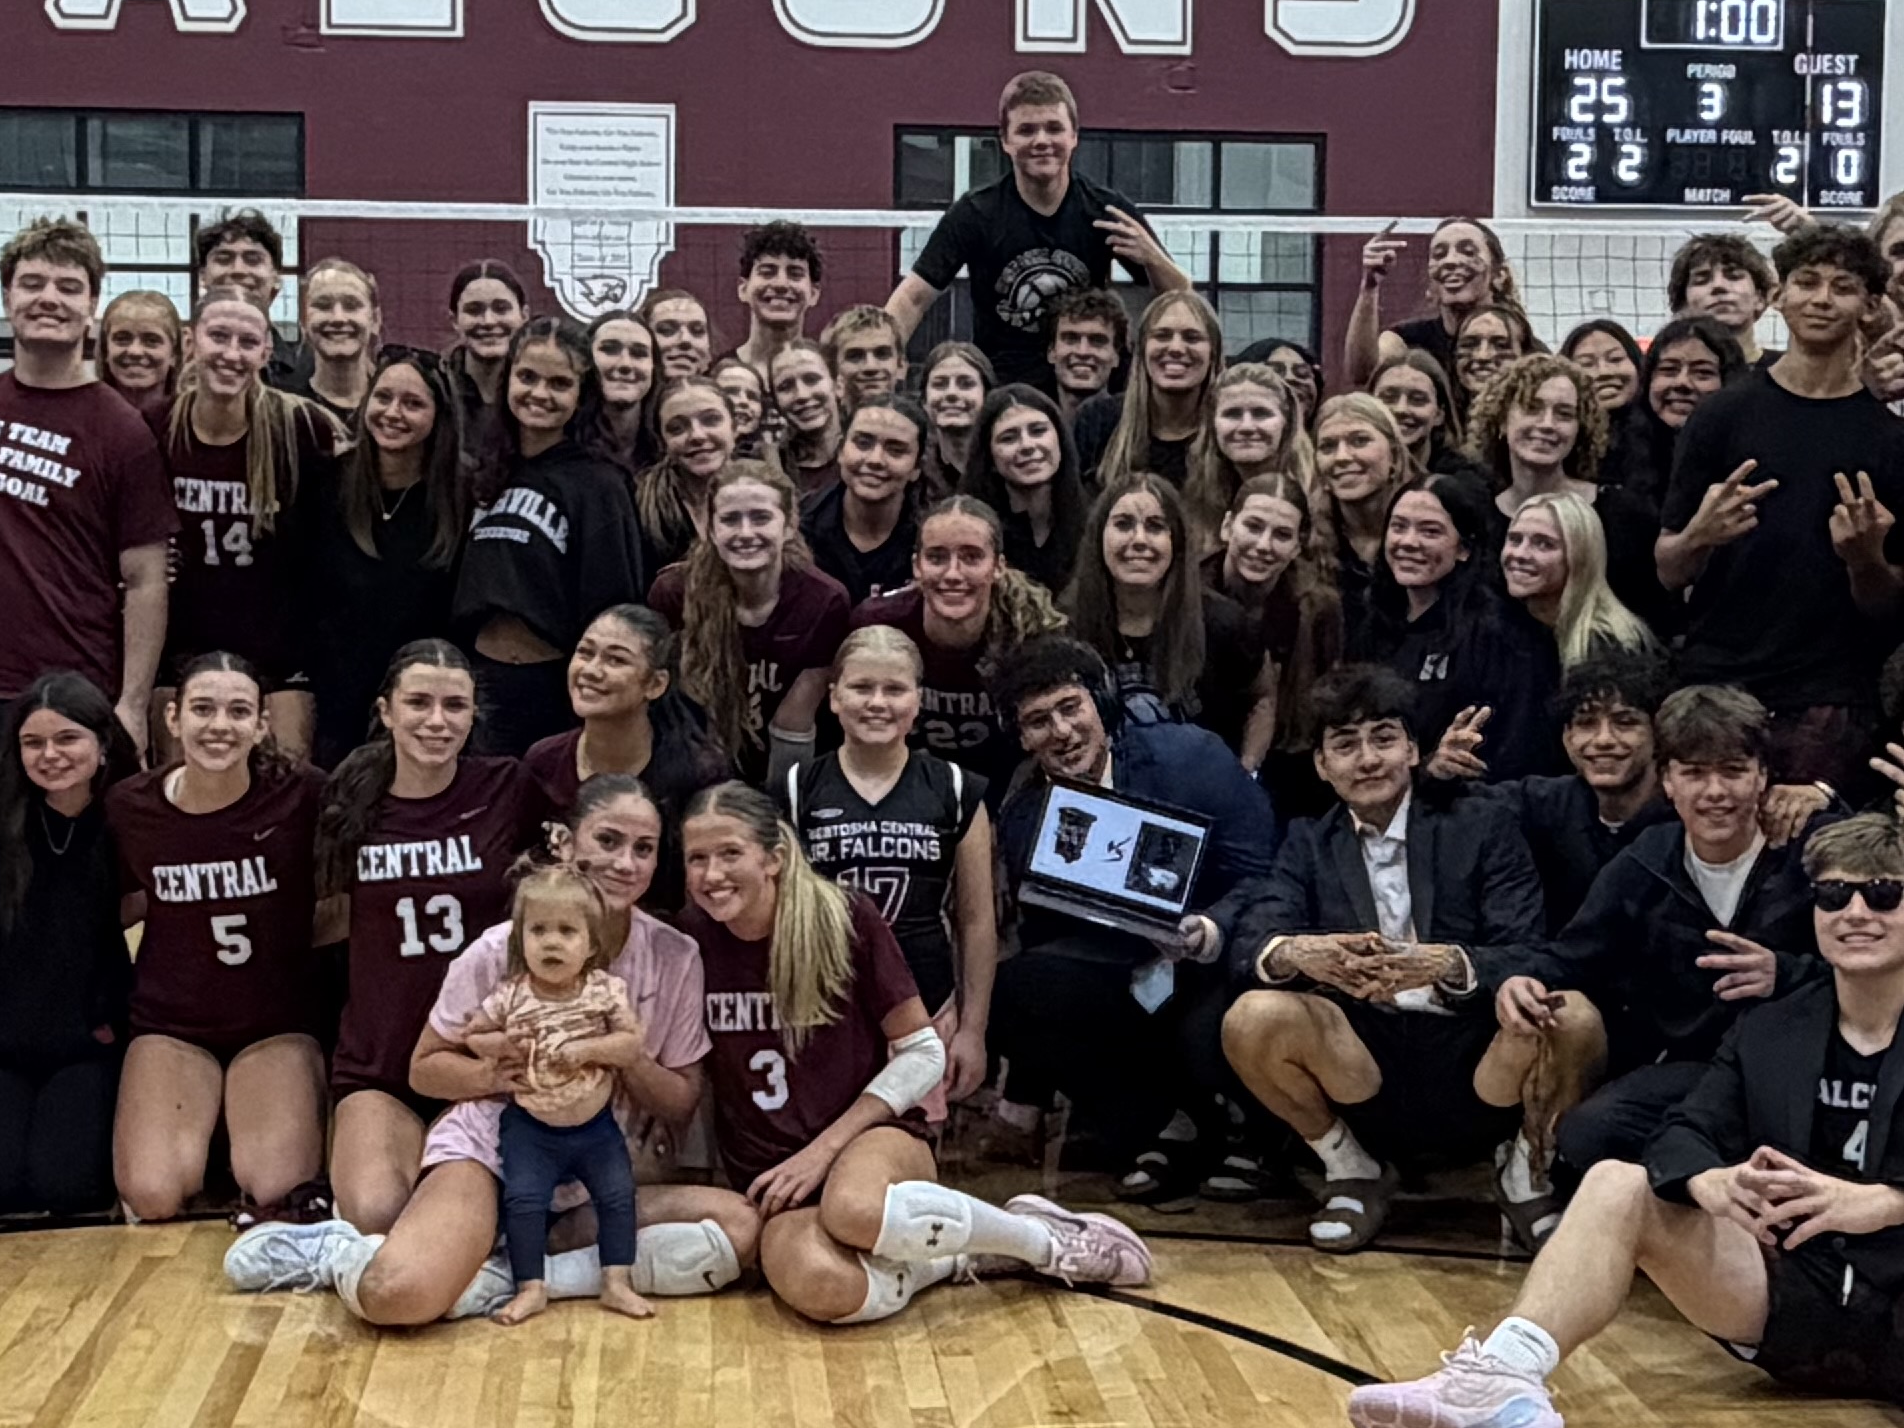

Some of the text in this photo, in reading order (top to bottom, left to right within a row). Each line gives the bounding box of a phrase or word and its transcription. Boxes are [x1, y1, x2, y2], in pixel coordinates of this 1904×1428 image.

[1564, 48, 1624, 71] HOME
[1793, 52, 1860, 76] GUEST
[1570, 76, 1628, 124] 25
[1699, 82, 1724, 121] 3
[1822, 80, 1863, 128] 13
[1666, 128, 1757, 146] PLAYER FOUL
[1567, 142, 1592, 181] 2
[1618, 143, 1643, 183] 2
[1776, 146, 1800, 185] 2
[1836, 148, 1860, 186] 0
[8, 421, 73, 457] TEAM
[200, 517, 255, 567] 14
[358, 834, 483, 883] CENTRAL
[839, 835, 942, 863] FALCONS
[152, 855, 279, 904] CENTRAL
[210, 913, 253, 967] 5
[395, 893, 466, 959] 13
[748, 1048, 790, 1112] 3
